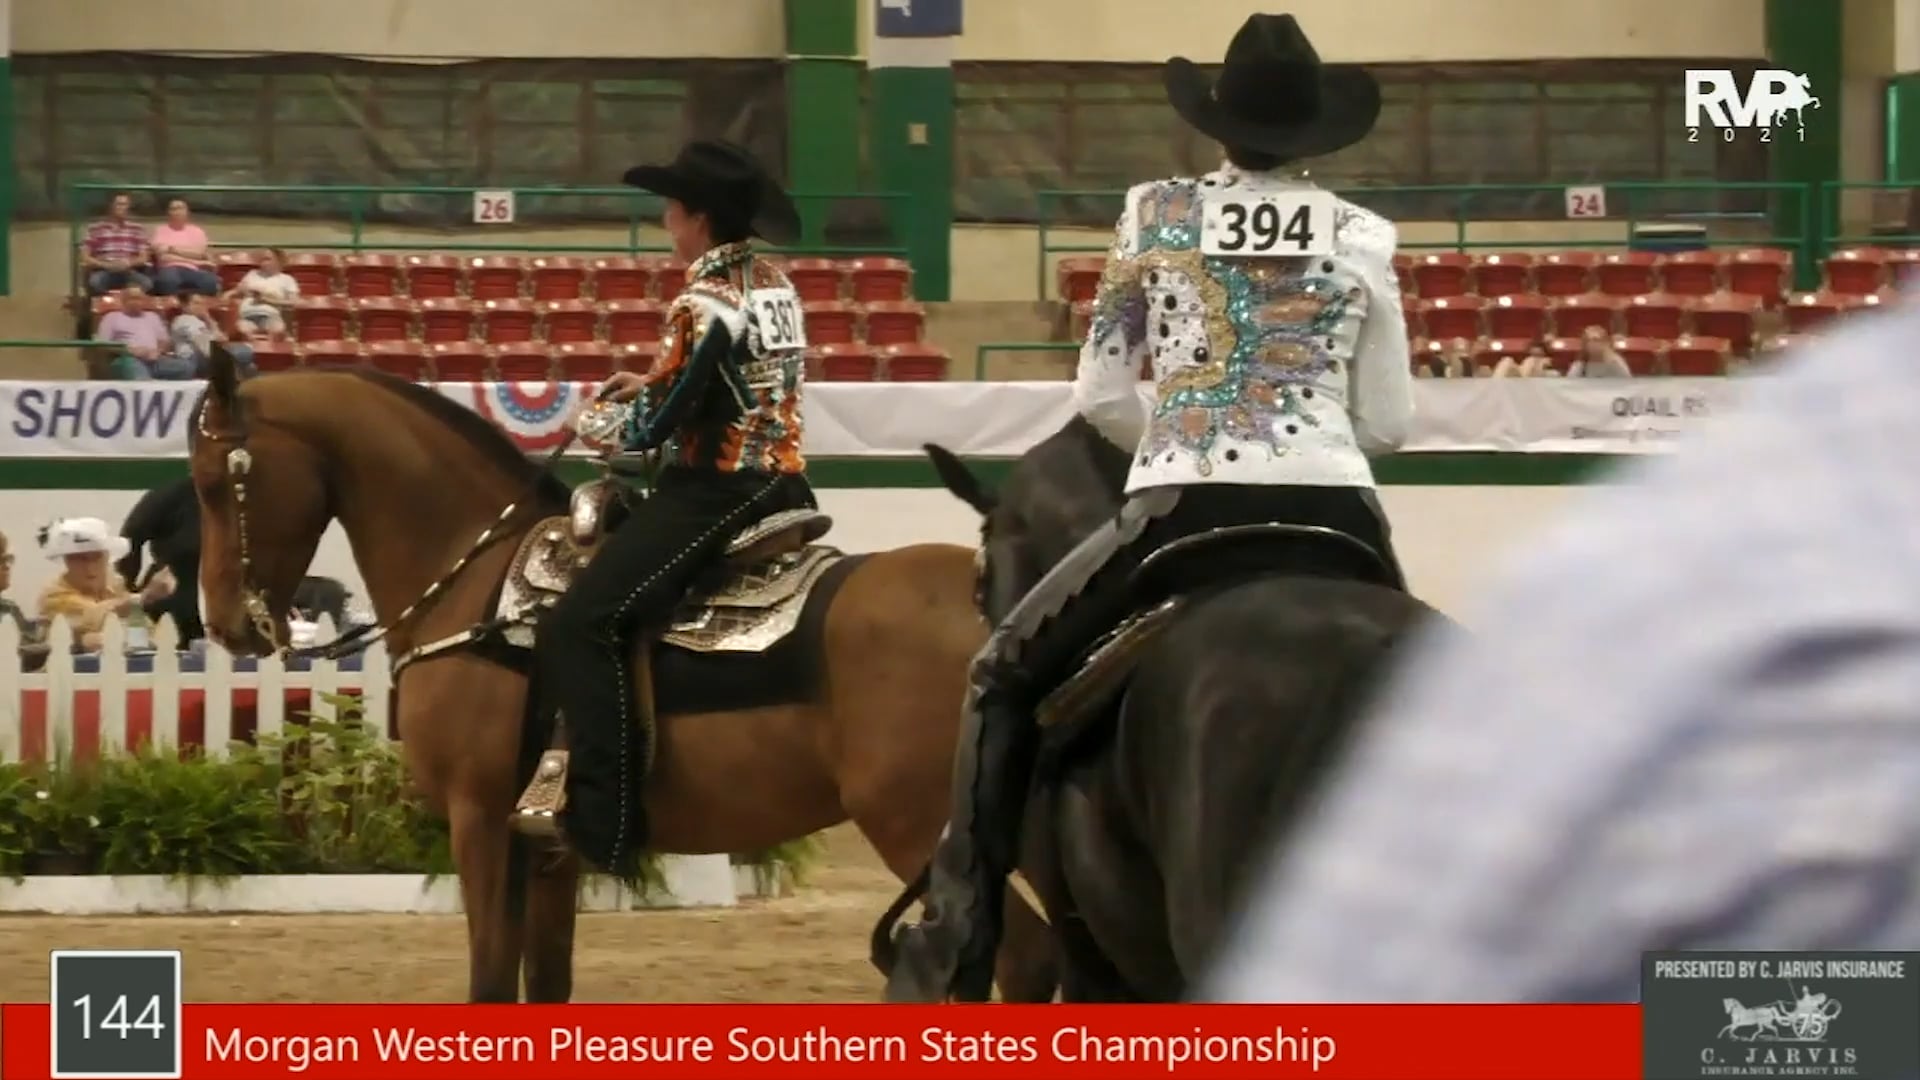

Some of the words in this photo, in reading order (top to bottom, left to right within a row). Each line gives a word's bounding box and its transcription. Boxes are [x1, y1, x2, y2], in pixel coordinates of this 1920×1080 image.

[480, 199, 509, 220] 26
[1571, 193, 1600, 216] 24
[1217, 202, 1314, 251] 394
[762, 299, 799, 344] 387
[12, 387, 184, 439] SHOW
[1611, 396, 1679, 417] QUAIL
